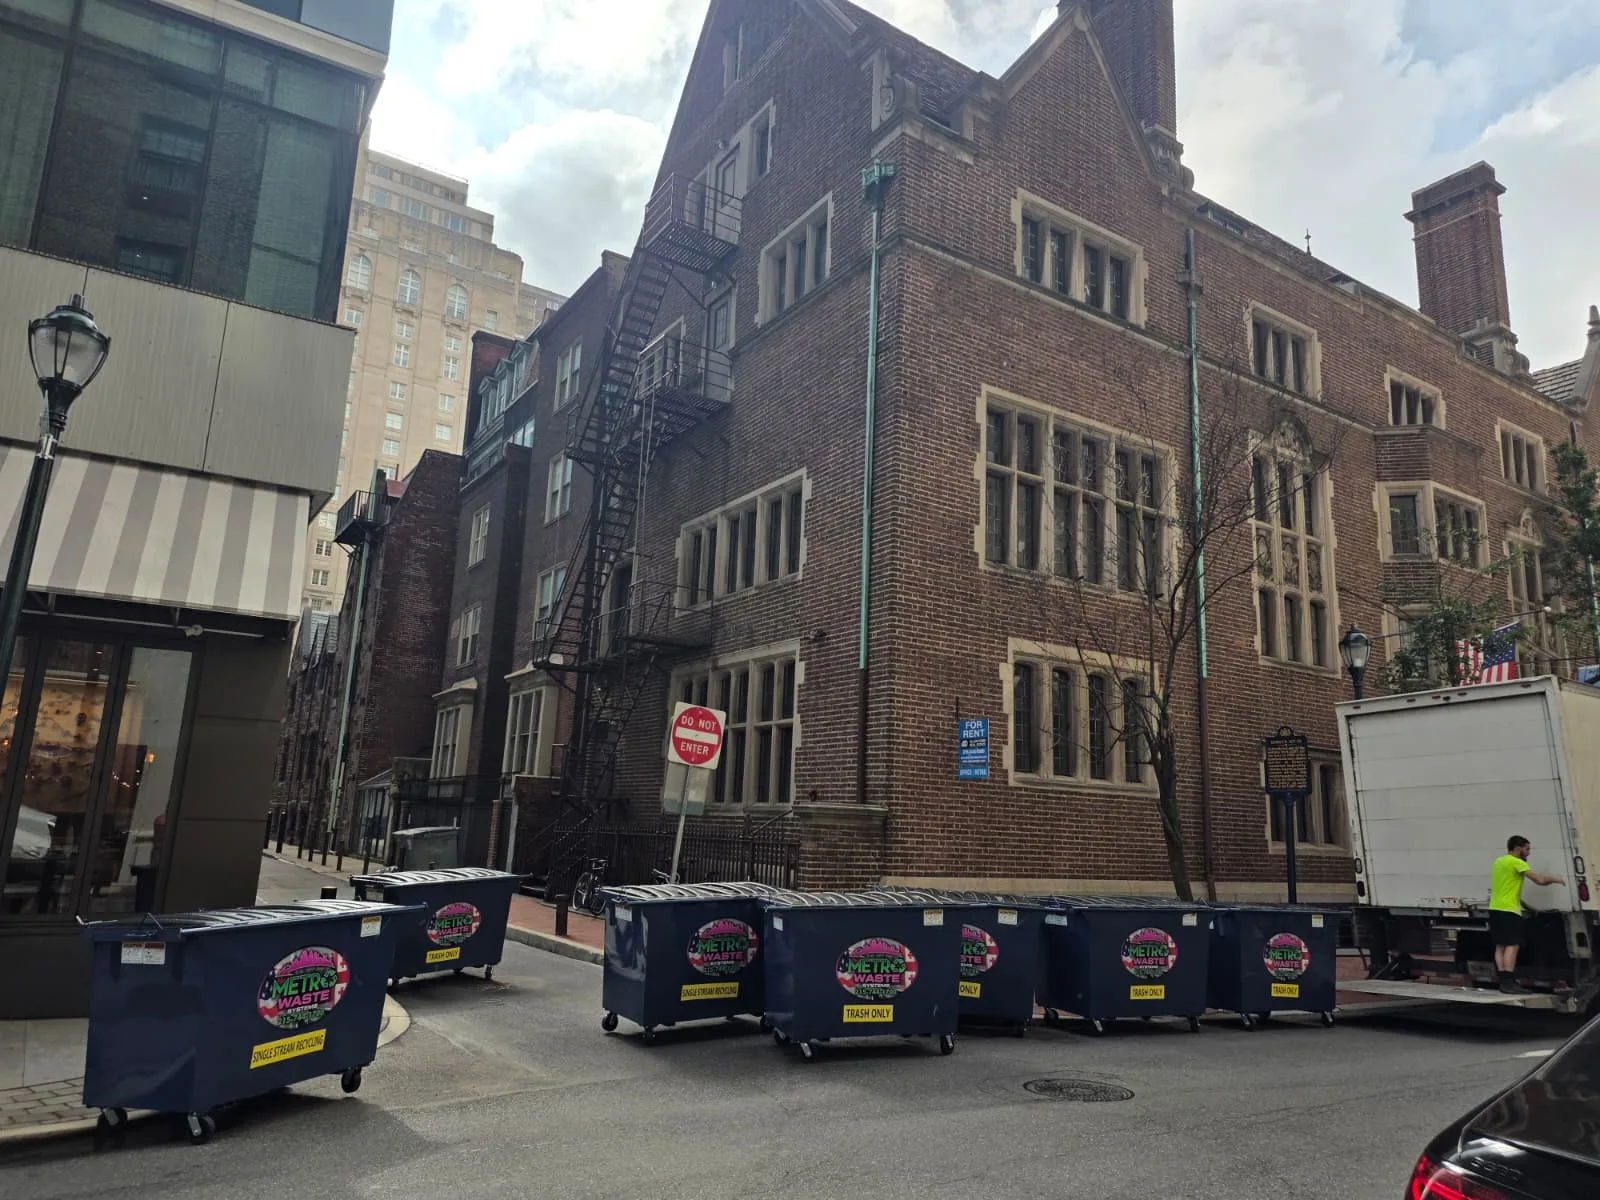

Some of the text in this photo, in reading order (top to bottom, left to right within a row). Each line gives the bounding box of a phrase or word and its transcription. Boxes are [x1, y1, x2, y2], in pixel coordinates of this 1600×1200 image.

[682, 716, 716, 731] DO NOT
[965, 721, 982, 729] FOR
[963, 730, 984, 738] RENT
[680, 742, 709, 755] ENTER
[439, 926, 469, 935] WASTE
[703, 951, 743, 961] WASTE
[848, 959, 906, 973] METRO
[854, 974, 900, 983] WASTE
[272, 970, 338, 1000] METRO
[960, 984, 978, 993] ONLY
[1133, 988, 1148, 996] TRASH
[278, 990, 330, 1009] WASTE
[846, 1009, 890, 1018] TRASH ONLY
[252, 1034, 324, 1063] SINGLE STREAM RECYCLING
